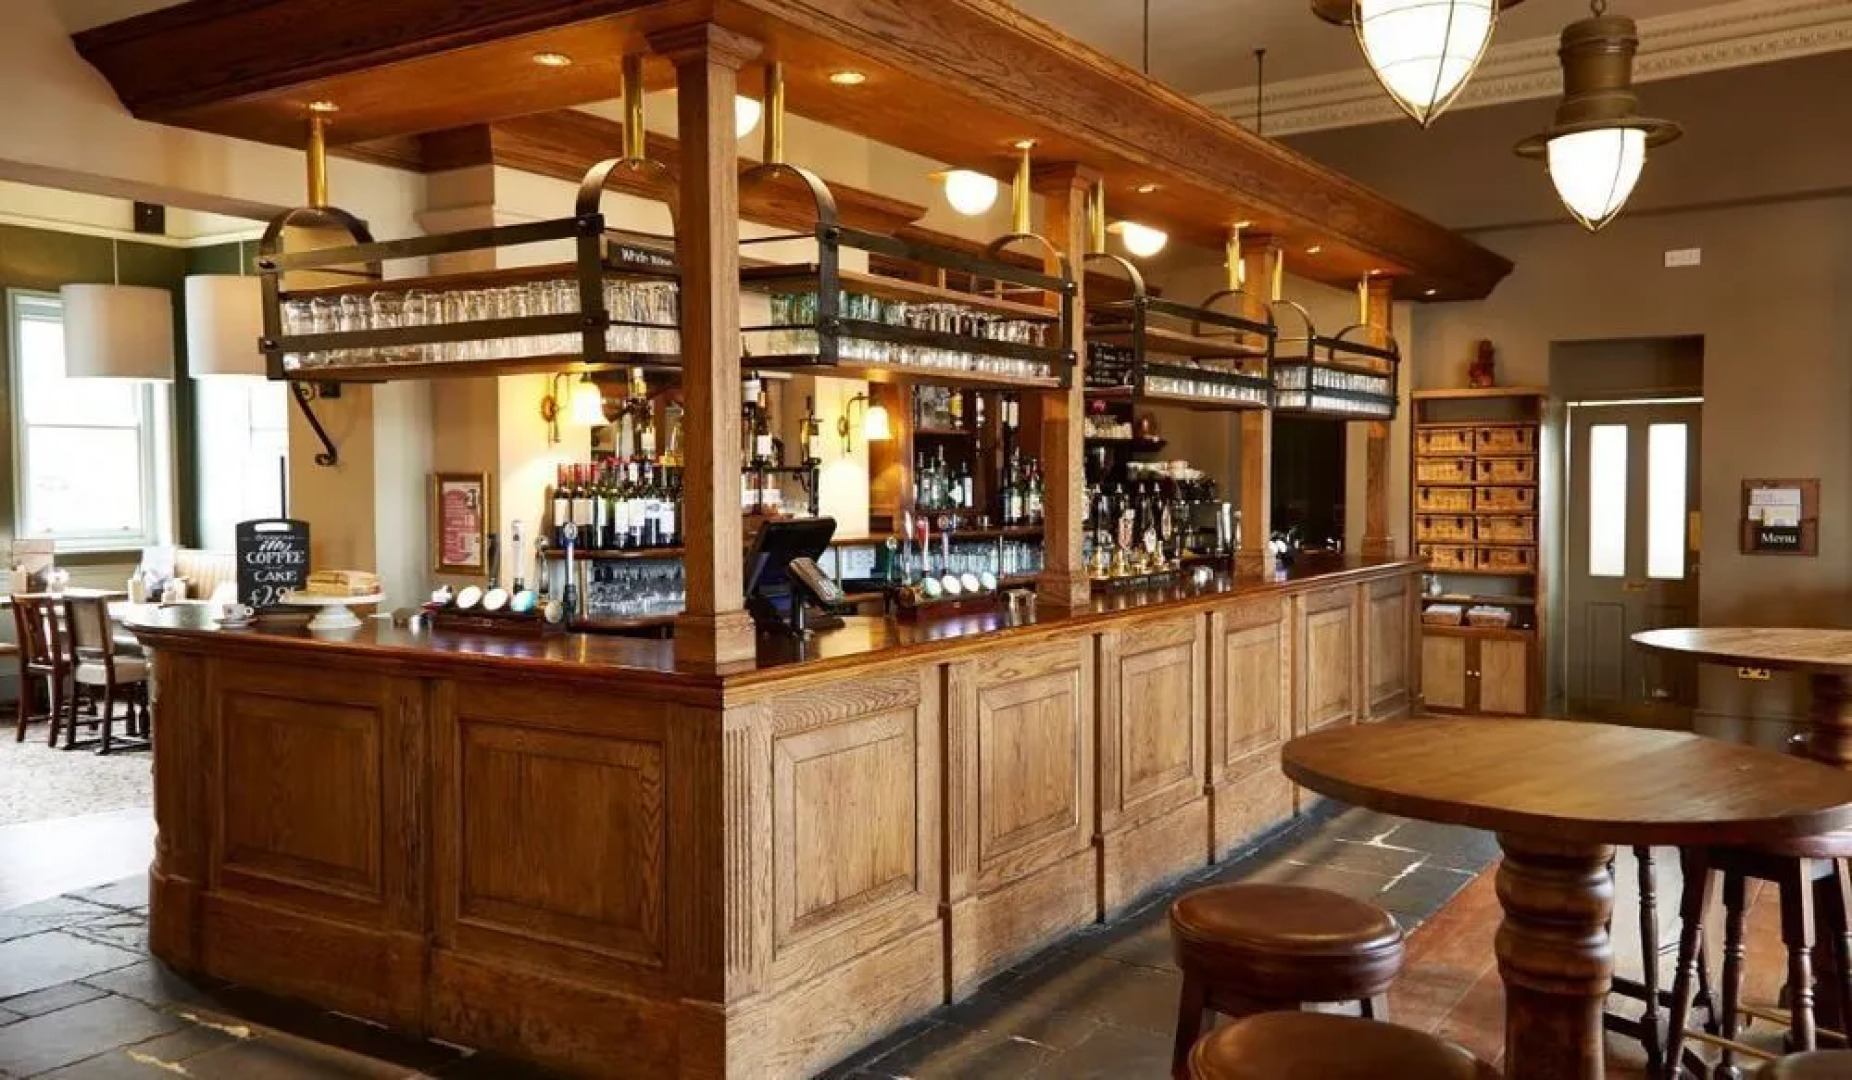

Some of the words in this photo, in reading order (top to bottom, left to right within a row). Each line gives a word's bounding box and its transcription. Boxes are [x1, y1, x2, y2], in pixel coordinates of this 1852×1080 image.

[1761, 533, 1797, 544] Menu
[245, 551, 305, 564] COFFEE
[254, 570, 297, 582] CAKE
